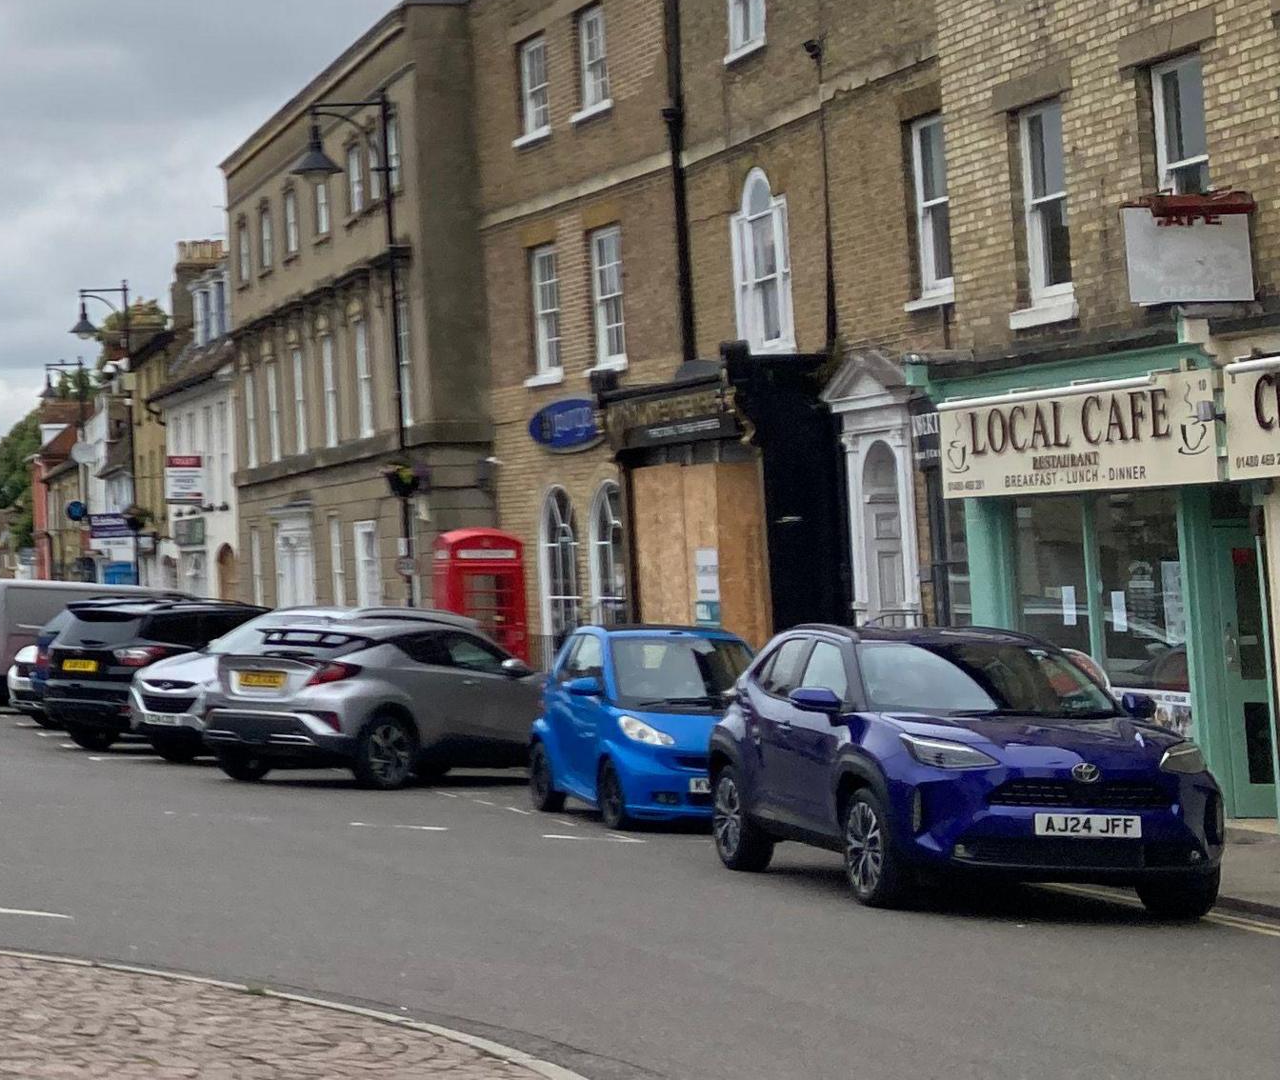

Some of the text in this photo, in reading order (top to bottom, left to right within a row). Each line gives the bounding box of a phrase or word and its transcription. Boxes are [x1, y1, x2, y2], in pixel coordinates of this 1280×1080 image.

[1253, 373, 1280, 431] C
[968, 388, 1171, 456] LOCAL CAFE
[1032, 451, 1100, 470] RESTAURANT
[1004, 471, 1057, 488] BREAKFAST
[1066, 469, 1099, 484] LUNCH
[1108, 466, 1147, 481] DINNER
[1045, 816, 1135, 835] AJ24 JFF
